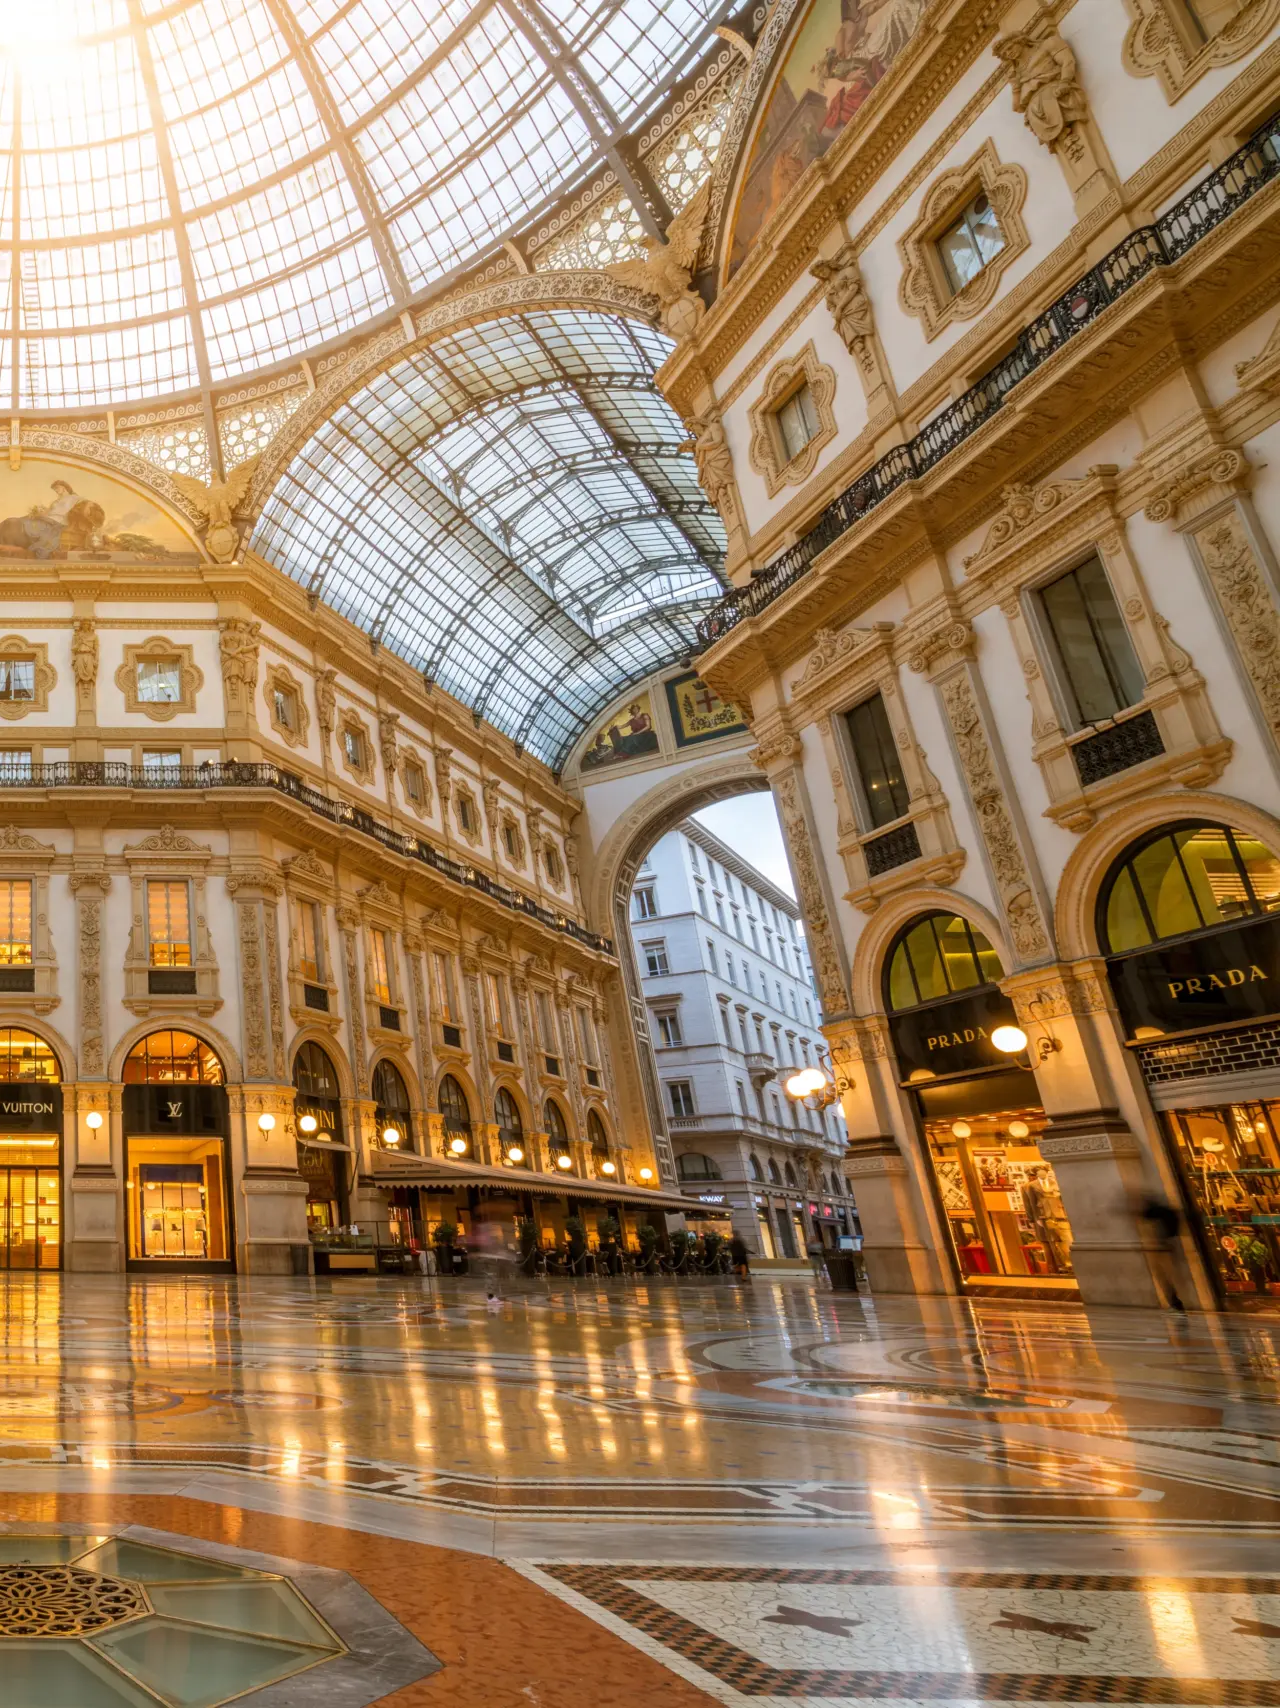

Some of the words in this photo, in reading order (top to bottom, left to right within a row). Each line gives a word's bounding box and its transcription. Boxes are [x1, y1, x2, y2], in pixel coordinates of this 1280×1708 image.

[1167, 964, 1269, 999] PRADA
[926, 1026, 988, 1051] PRADA
[2, 1102, 53, 1114] VUITTON
